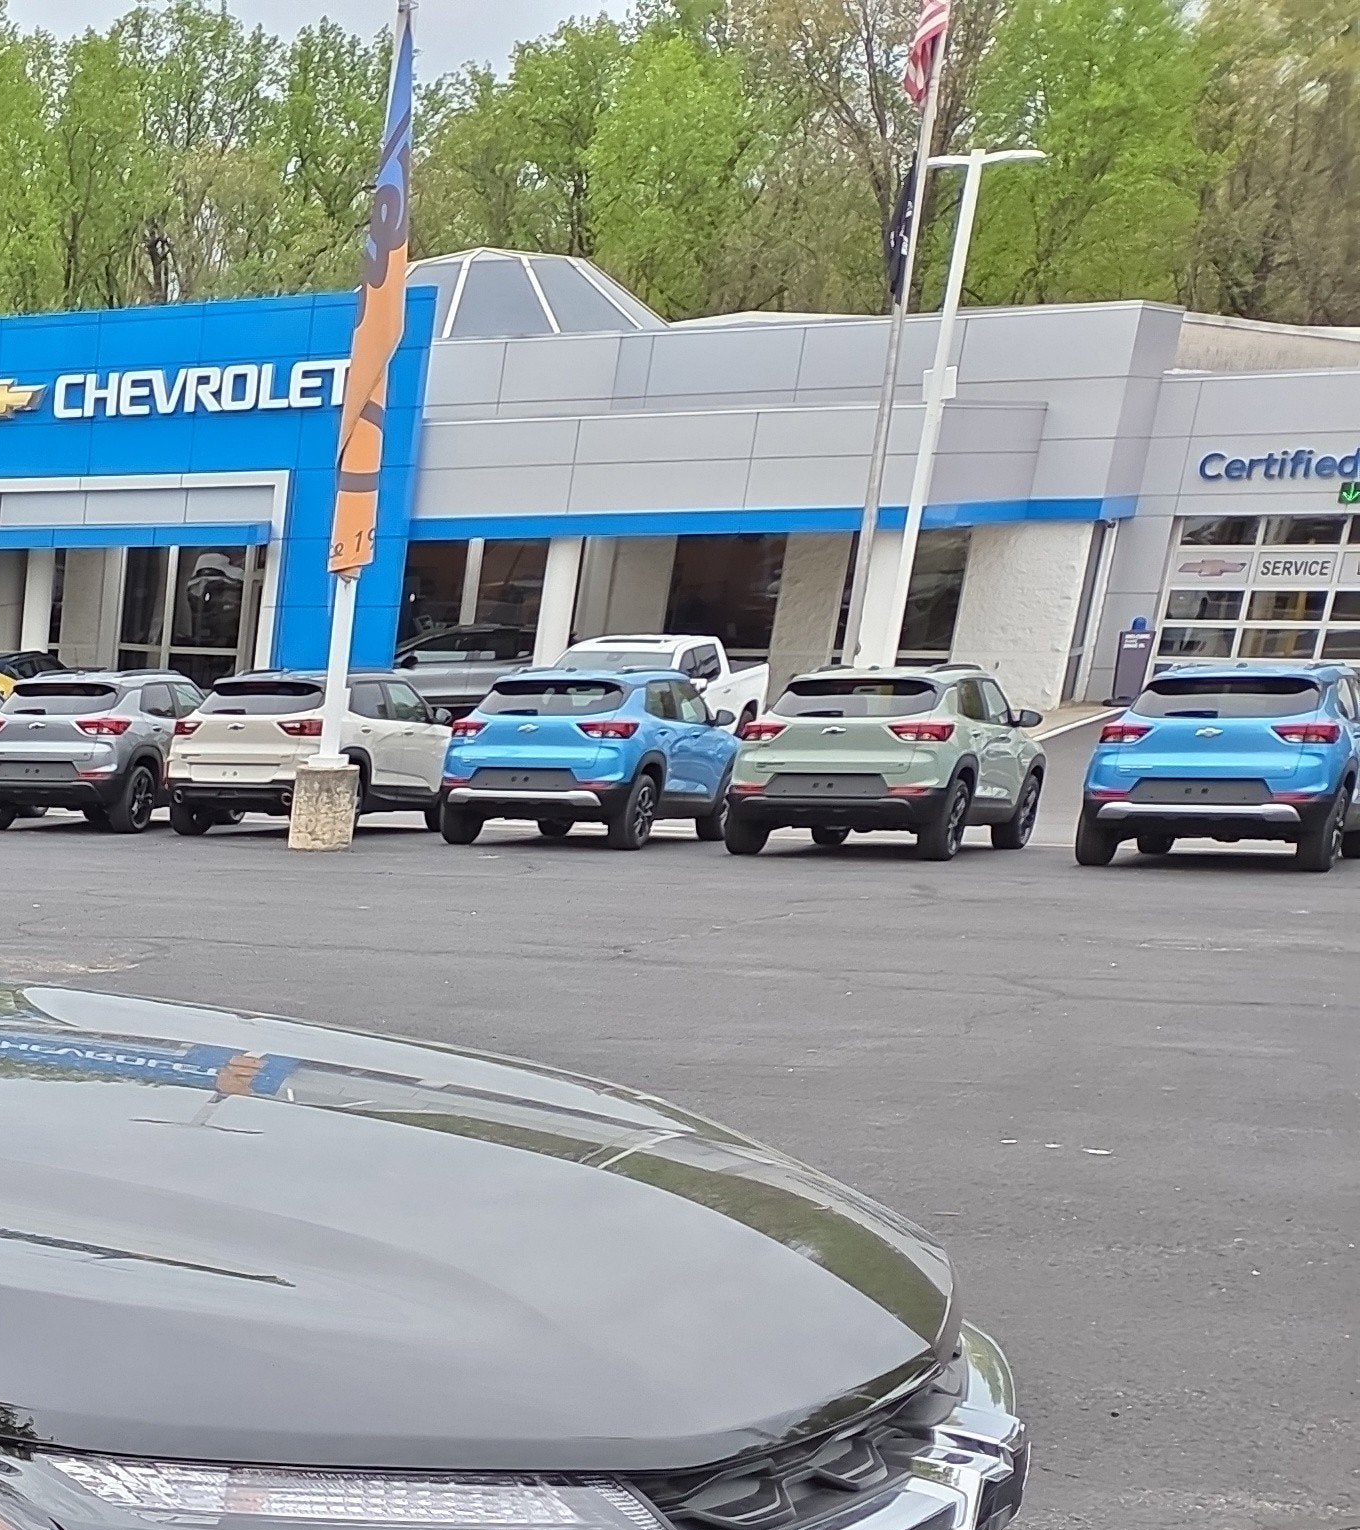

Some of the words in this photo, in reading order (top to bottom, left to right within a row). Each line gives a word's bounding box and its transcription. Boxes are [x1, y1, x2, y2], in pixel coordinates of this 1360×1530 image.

[53, 359, 351, 419] CHEVROLET
[1199, 448, 1360, 481] Certified
[1260, 559, 1331, 577] SERVICE
